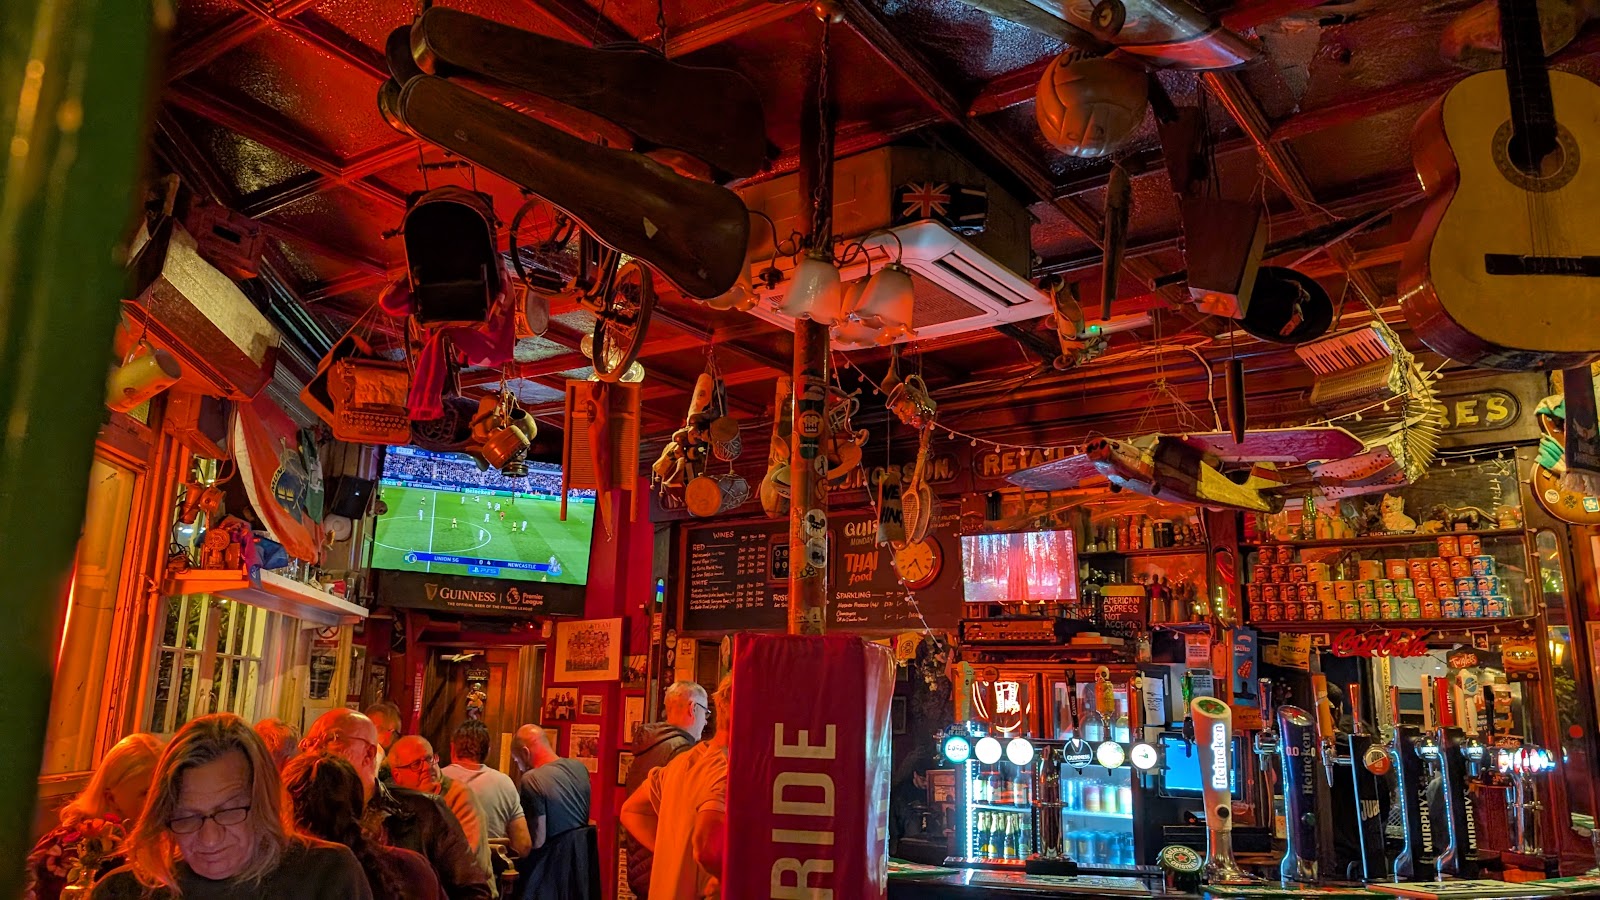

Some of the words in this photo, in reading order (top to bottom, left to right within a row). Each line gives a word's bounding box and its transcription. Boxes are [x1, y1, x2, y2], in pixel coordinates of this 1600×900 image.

[712, 530, 735, 539] WINES
[850, 536, 875, 547] MONDAY
[692, 543, 706, 551] RED
[508, 562, 537, 570] NEWCASTLE
[844, 550, 878, 573] THAI
[848, 570, 873, 586] food
[440, 587, 497, 602] GUINNESS
[522, 592, 544, 600] Premier
[835, 591, 871, 600] SPARKLING
[522, 598, 544, 607] League
[1103, 596, 1140, 605] AMERICAN
[1103, 604, 1139, 614] EXPRESS
[1104, 613, 1121, 621] NOT
[1105, 620, 1142, 629] ACCEPTED
[1111, 629, 1135, 638] SORRY
[1449, 652, 1478, 668] Twiglets
[1214, 724, 1227, 787] Heineken
[1286, 746, 1300, 757] 0.0
[1066, 754, 1091, 762] GUINNESS
[1302, 731, 1314, 796] Heineken
[1418, 788, 1434, 853] MURPHY'S
[1463, 788, 1478, 850] MURPHY'S
[1164, 847, 1197, 861] Heineken
[1170, 859, 1198, 870] ORIGINAL
